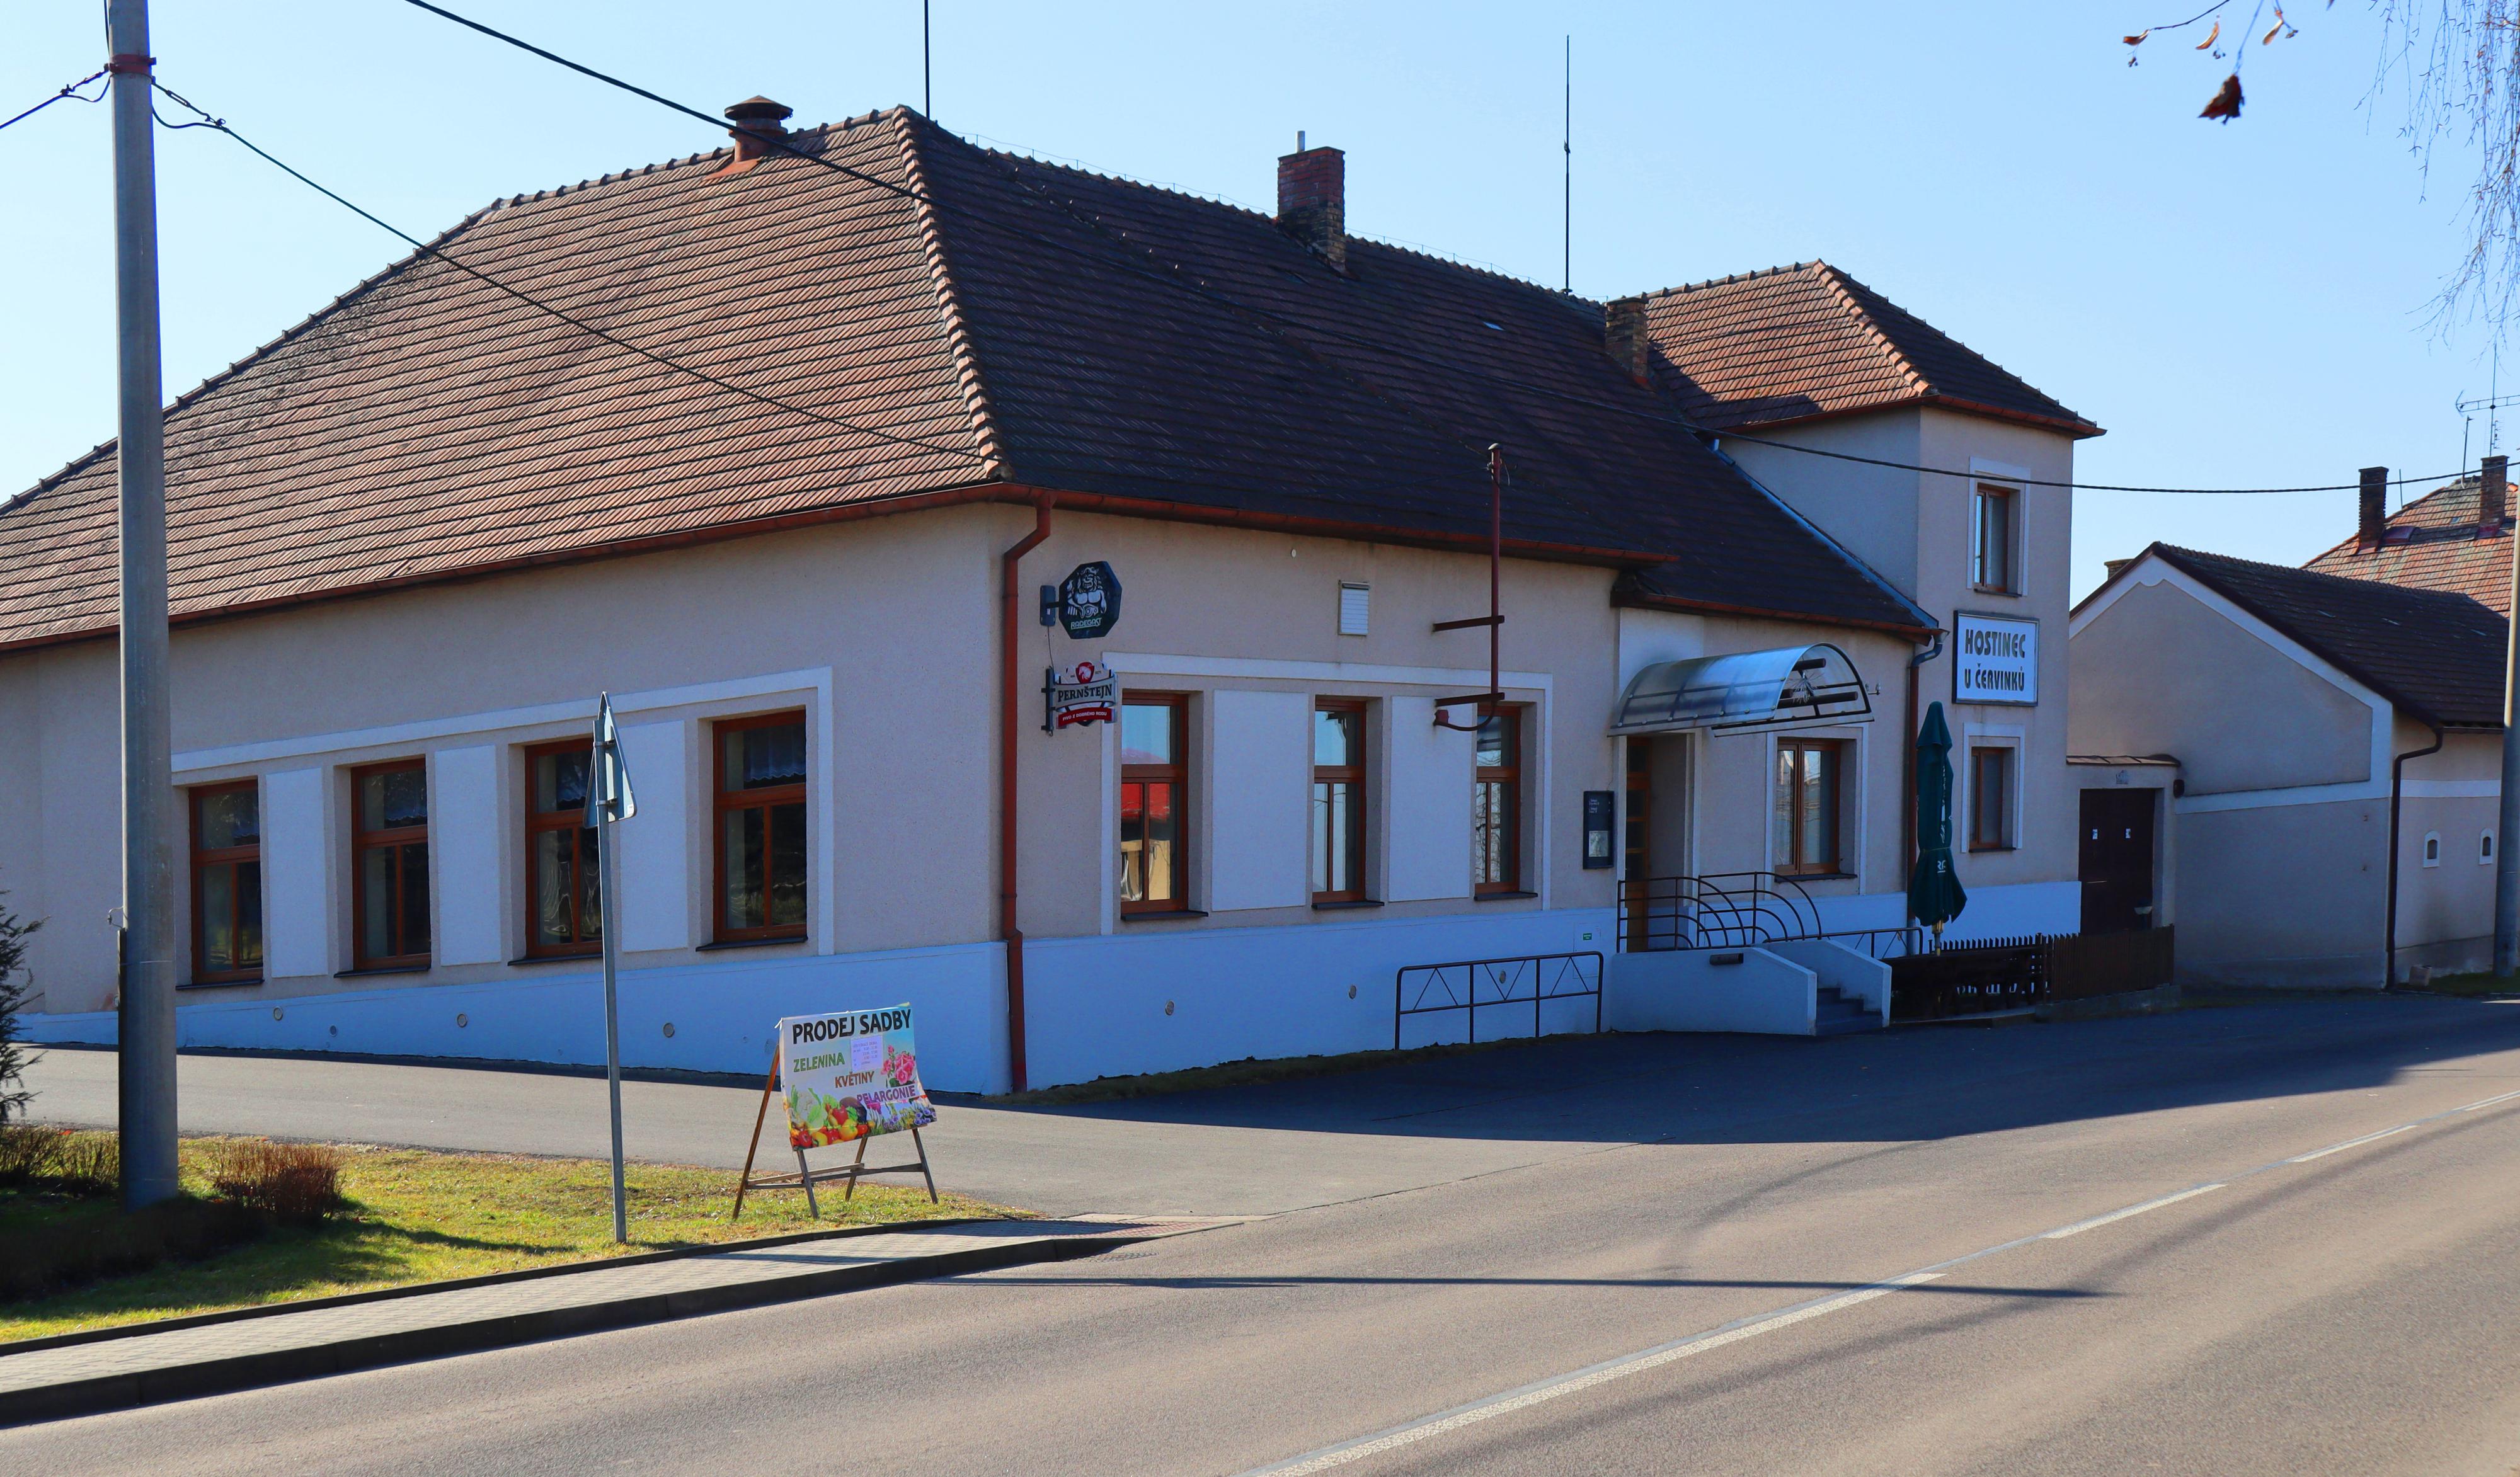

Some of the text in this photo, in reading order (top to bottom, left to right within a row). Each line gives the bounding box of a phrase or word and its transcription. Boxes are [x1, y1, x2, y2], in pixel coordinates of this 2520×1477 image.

[1071, 618, 1102, 629] RADEGAST
[1965, 629, 2026, 658] HOSTINEC
[1964, 663, 2025, 692] U ČERVINKŮ
[1058, 684, 1112, 702] PERNŠTEJN
[793, 1009, 911, 1044] PRODEJ SADBY
[793, 1052, 845, 1072] ZELENINA
[835, 1071, 874, 1088] KVĚTINY
[856, 1085, 915, 1103] PELARGONIE
